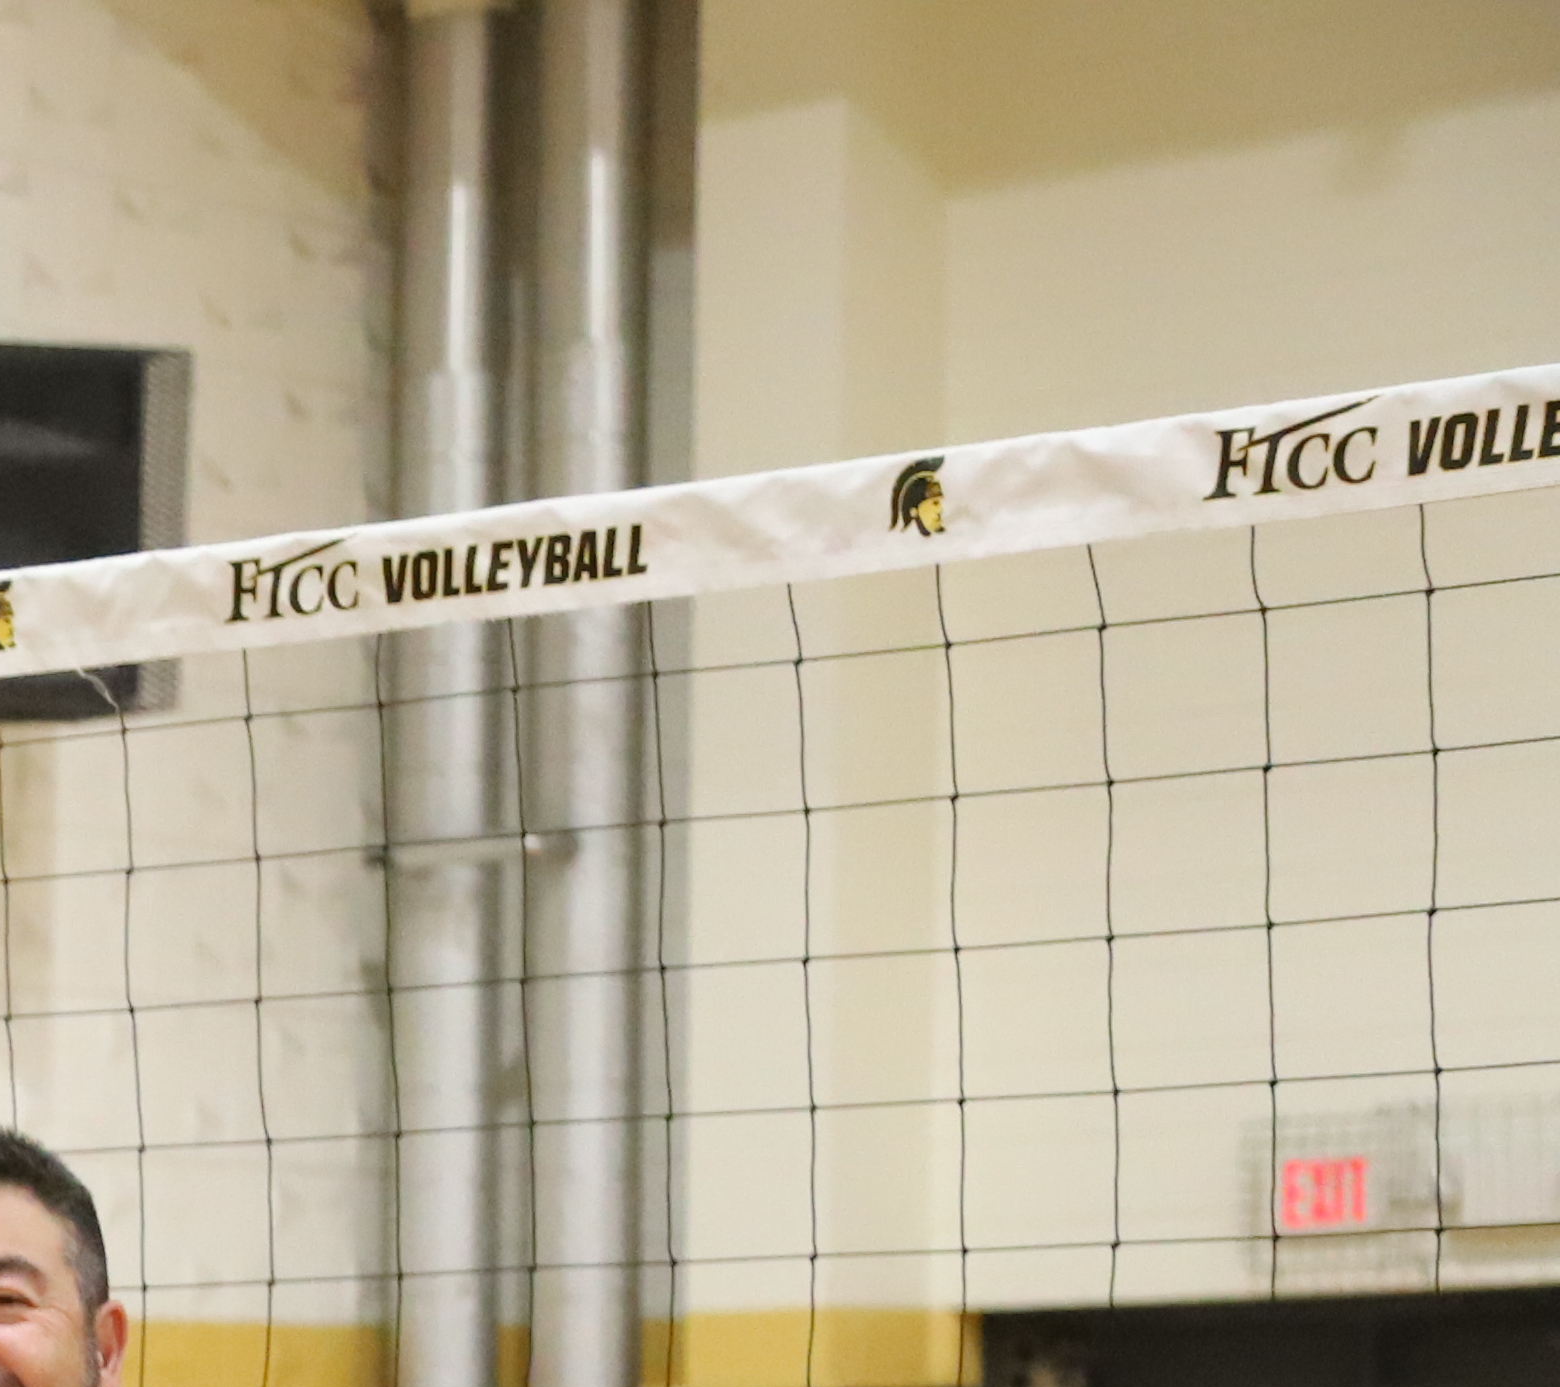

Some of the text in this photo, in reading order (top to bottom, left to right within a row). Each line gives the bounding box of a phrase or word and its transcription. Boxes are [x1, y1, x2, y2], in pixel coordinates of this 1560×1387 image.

[1203, 396, 1379, 500] FTCC
[224, 524, 648, 624] FTCC VOLLEYBALL
[1282, 1155, 1367, 1228] EXIT
